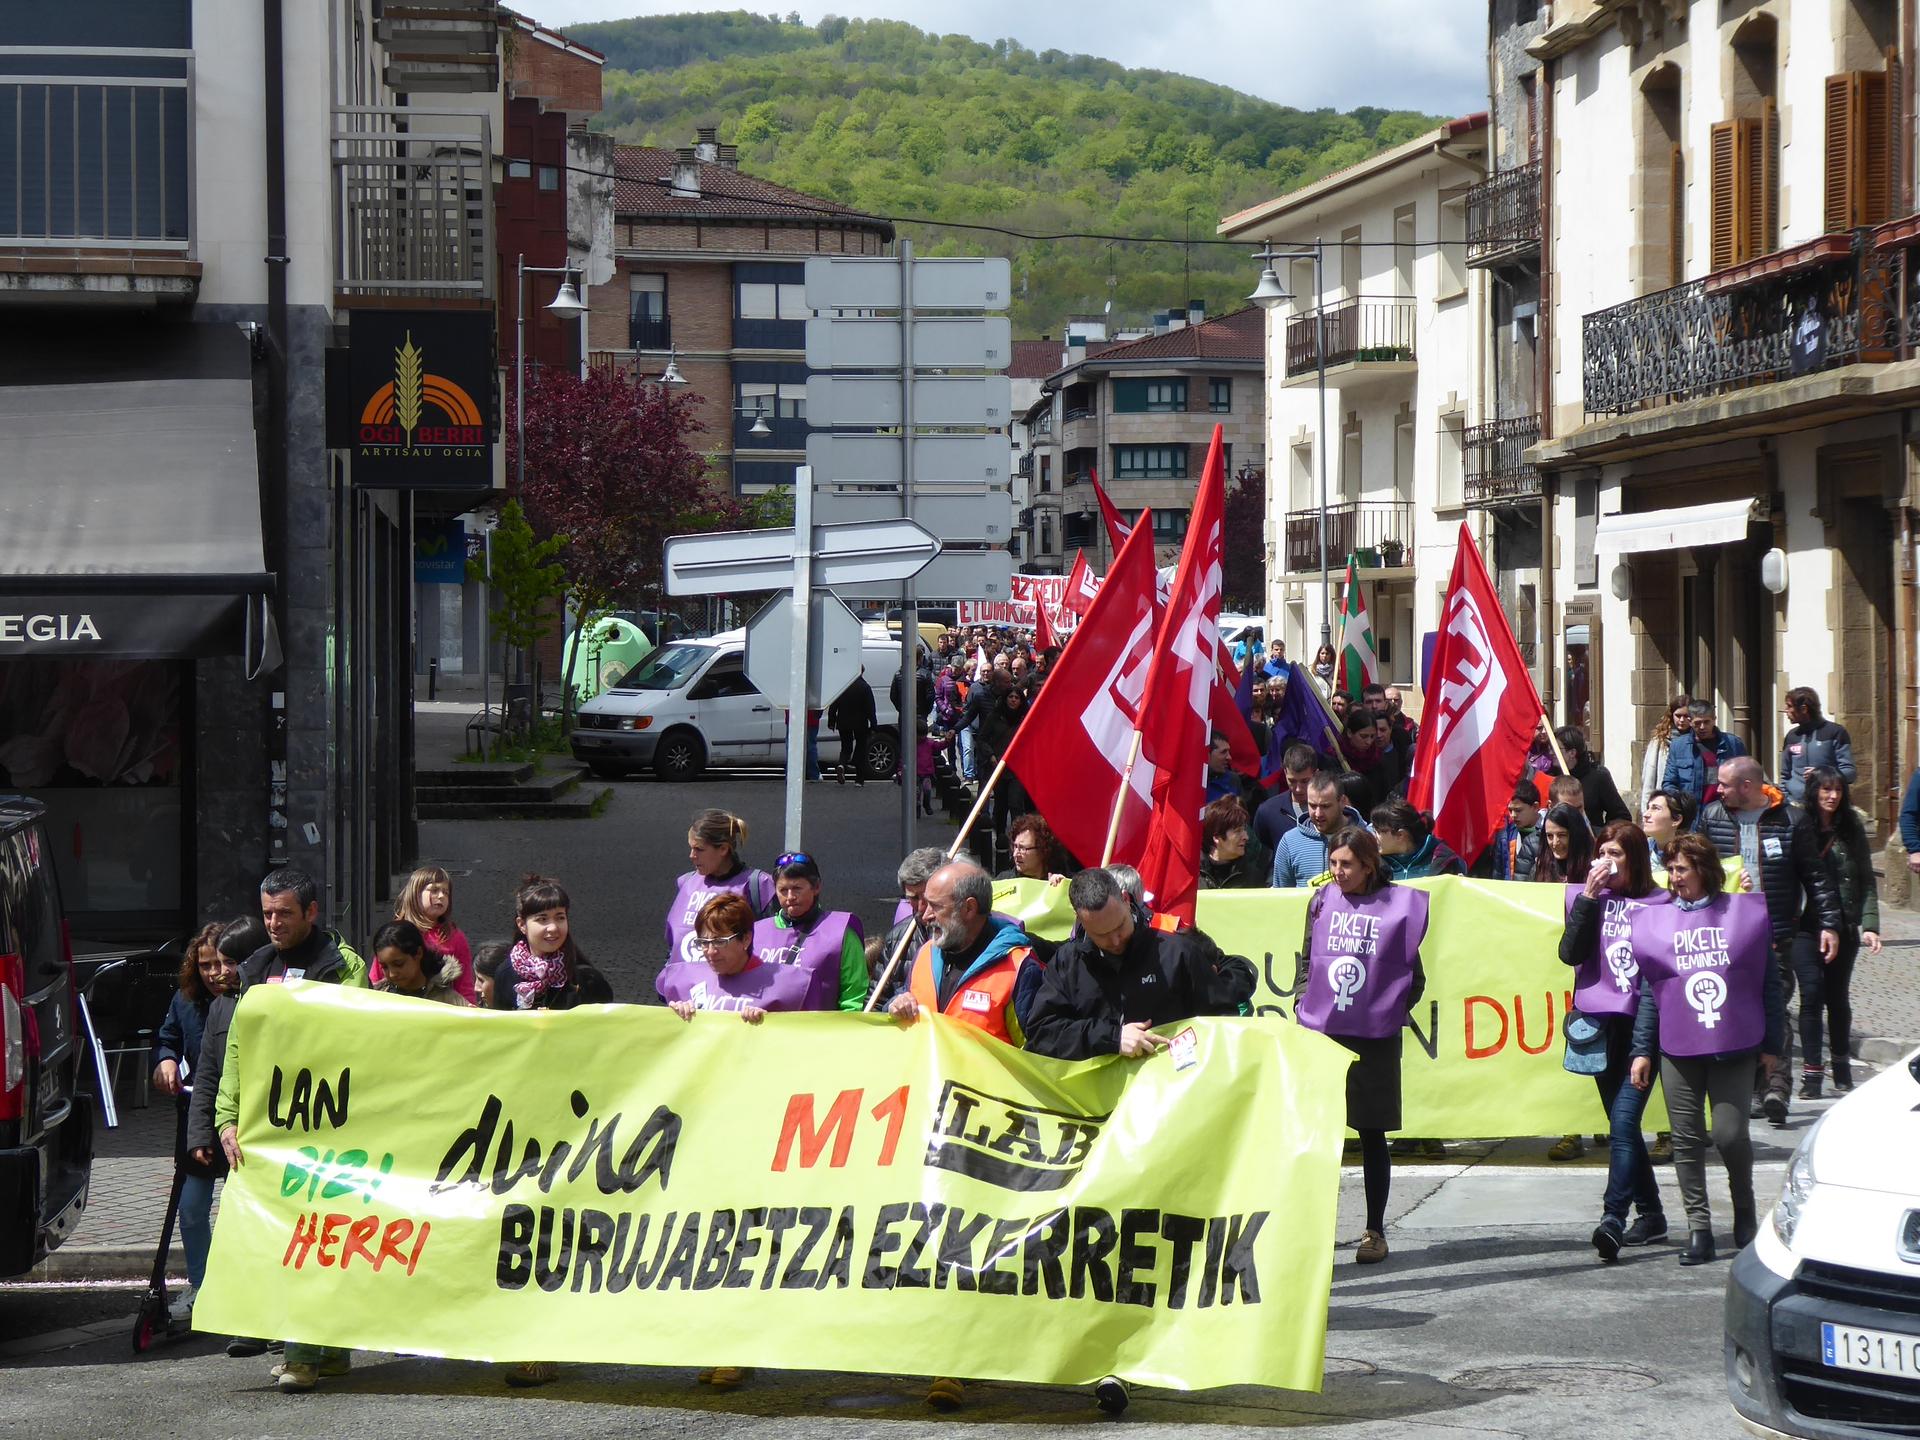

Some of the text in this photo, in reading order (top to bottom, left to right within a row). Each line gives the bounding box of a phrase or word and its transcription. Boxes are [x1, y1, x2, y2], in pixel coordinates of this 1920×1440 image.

[360, 426, 483, 444] OGI BERRI
[361, 447, 482, 456] ARTISAU OGIA
[1327, 935, 1377, 955] FEMINISTA
[1329, 911, 1382, 939] PIKETE
[1673, 926, 1729, 954] PIKETE
[1676, 950, 1731, 970] FEMINISTA
[268, 1064, 350, 1132] LAN
[428, 1089, 683, 1196] duina
[771, 1085, 910, 1172] M1
[941, 1091, 1100, 1166] LAB
[282, 1212, 431, 1276] HERRI
[496, 1201, 1270, 1310] BURUJABETZA EZKERRETIK
